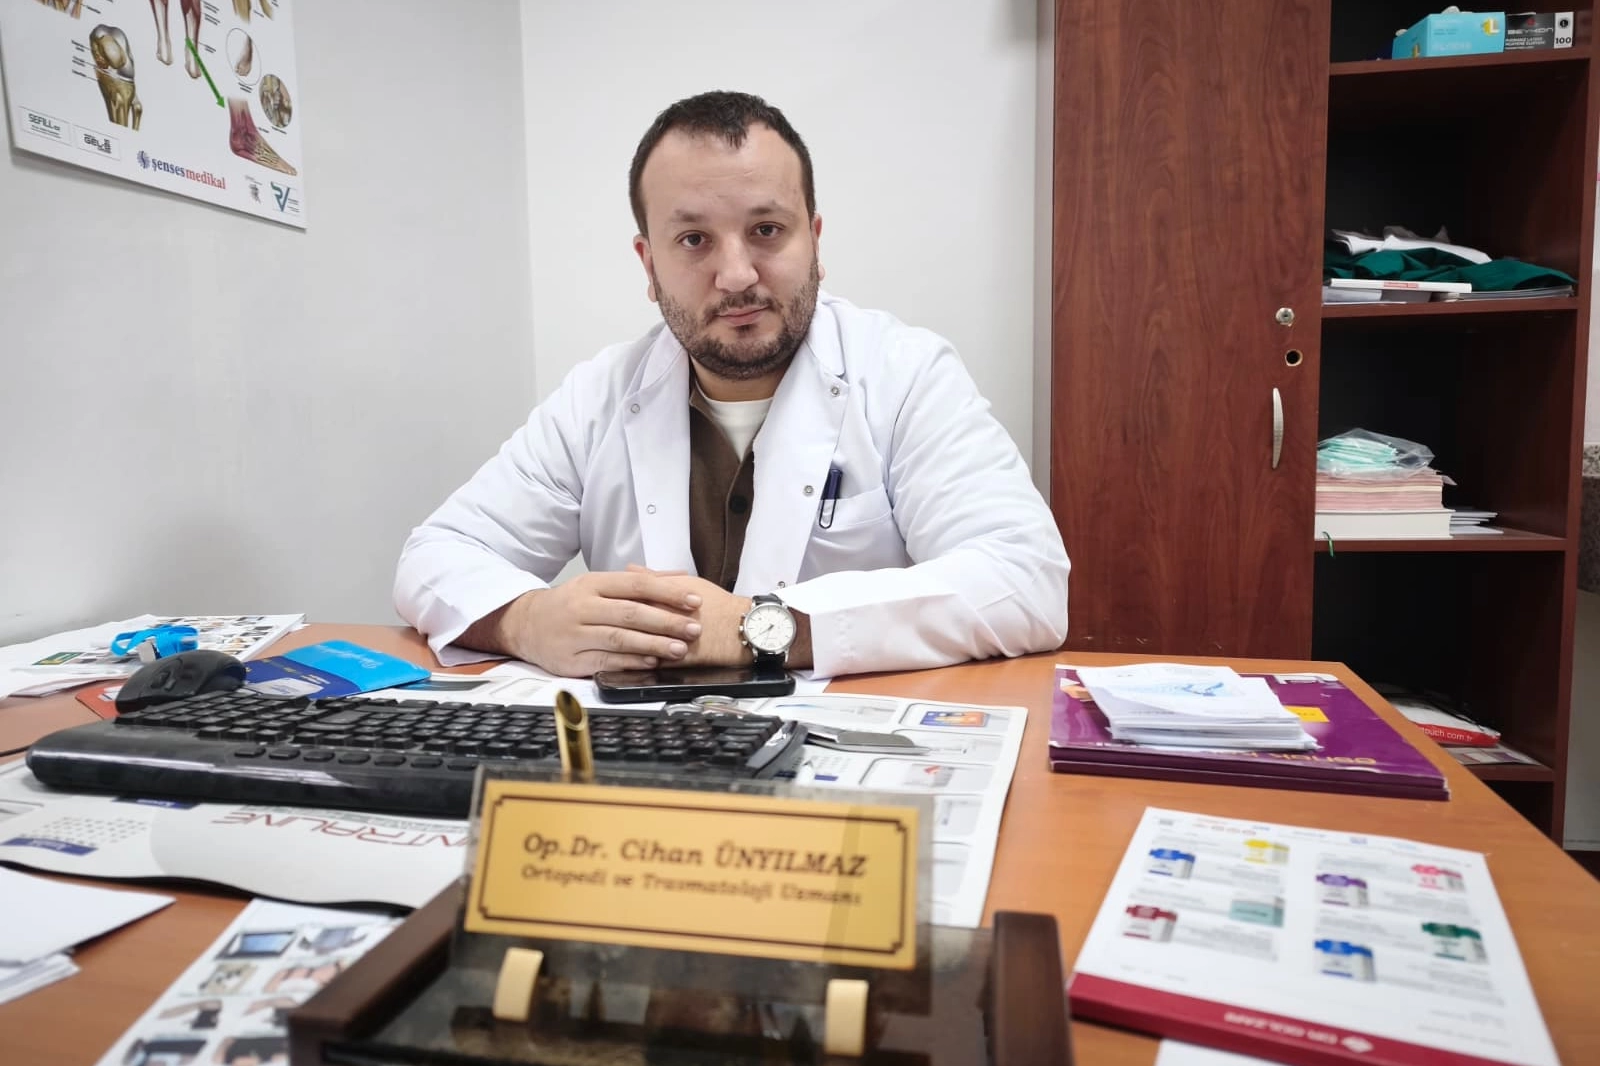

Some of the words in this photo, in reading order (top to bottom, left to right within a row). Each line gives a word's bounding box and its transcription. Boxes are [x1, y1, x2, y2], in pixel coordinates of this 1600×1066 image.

[1555, 36, 1572, 45] 100
[152, 157, 226, 190] şensesmedikal
[620, 837, 703, 867] Cihan
[715, 840, 866, 878] ÜNYILMAZ
[521, 864, 606, 887] Ortopedi
[613, 872, 634, 887] ve
